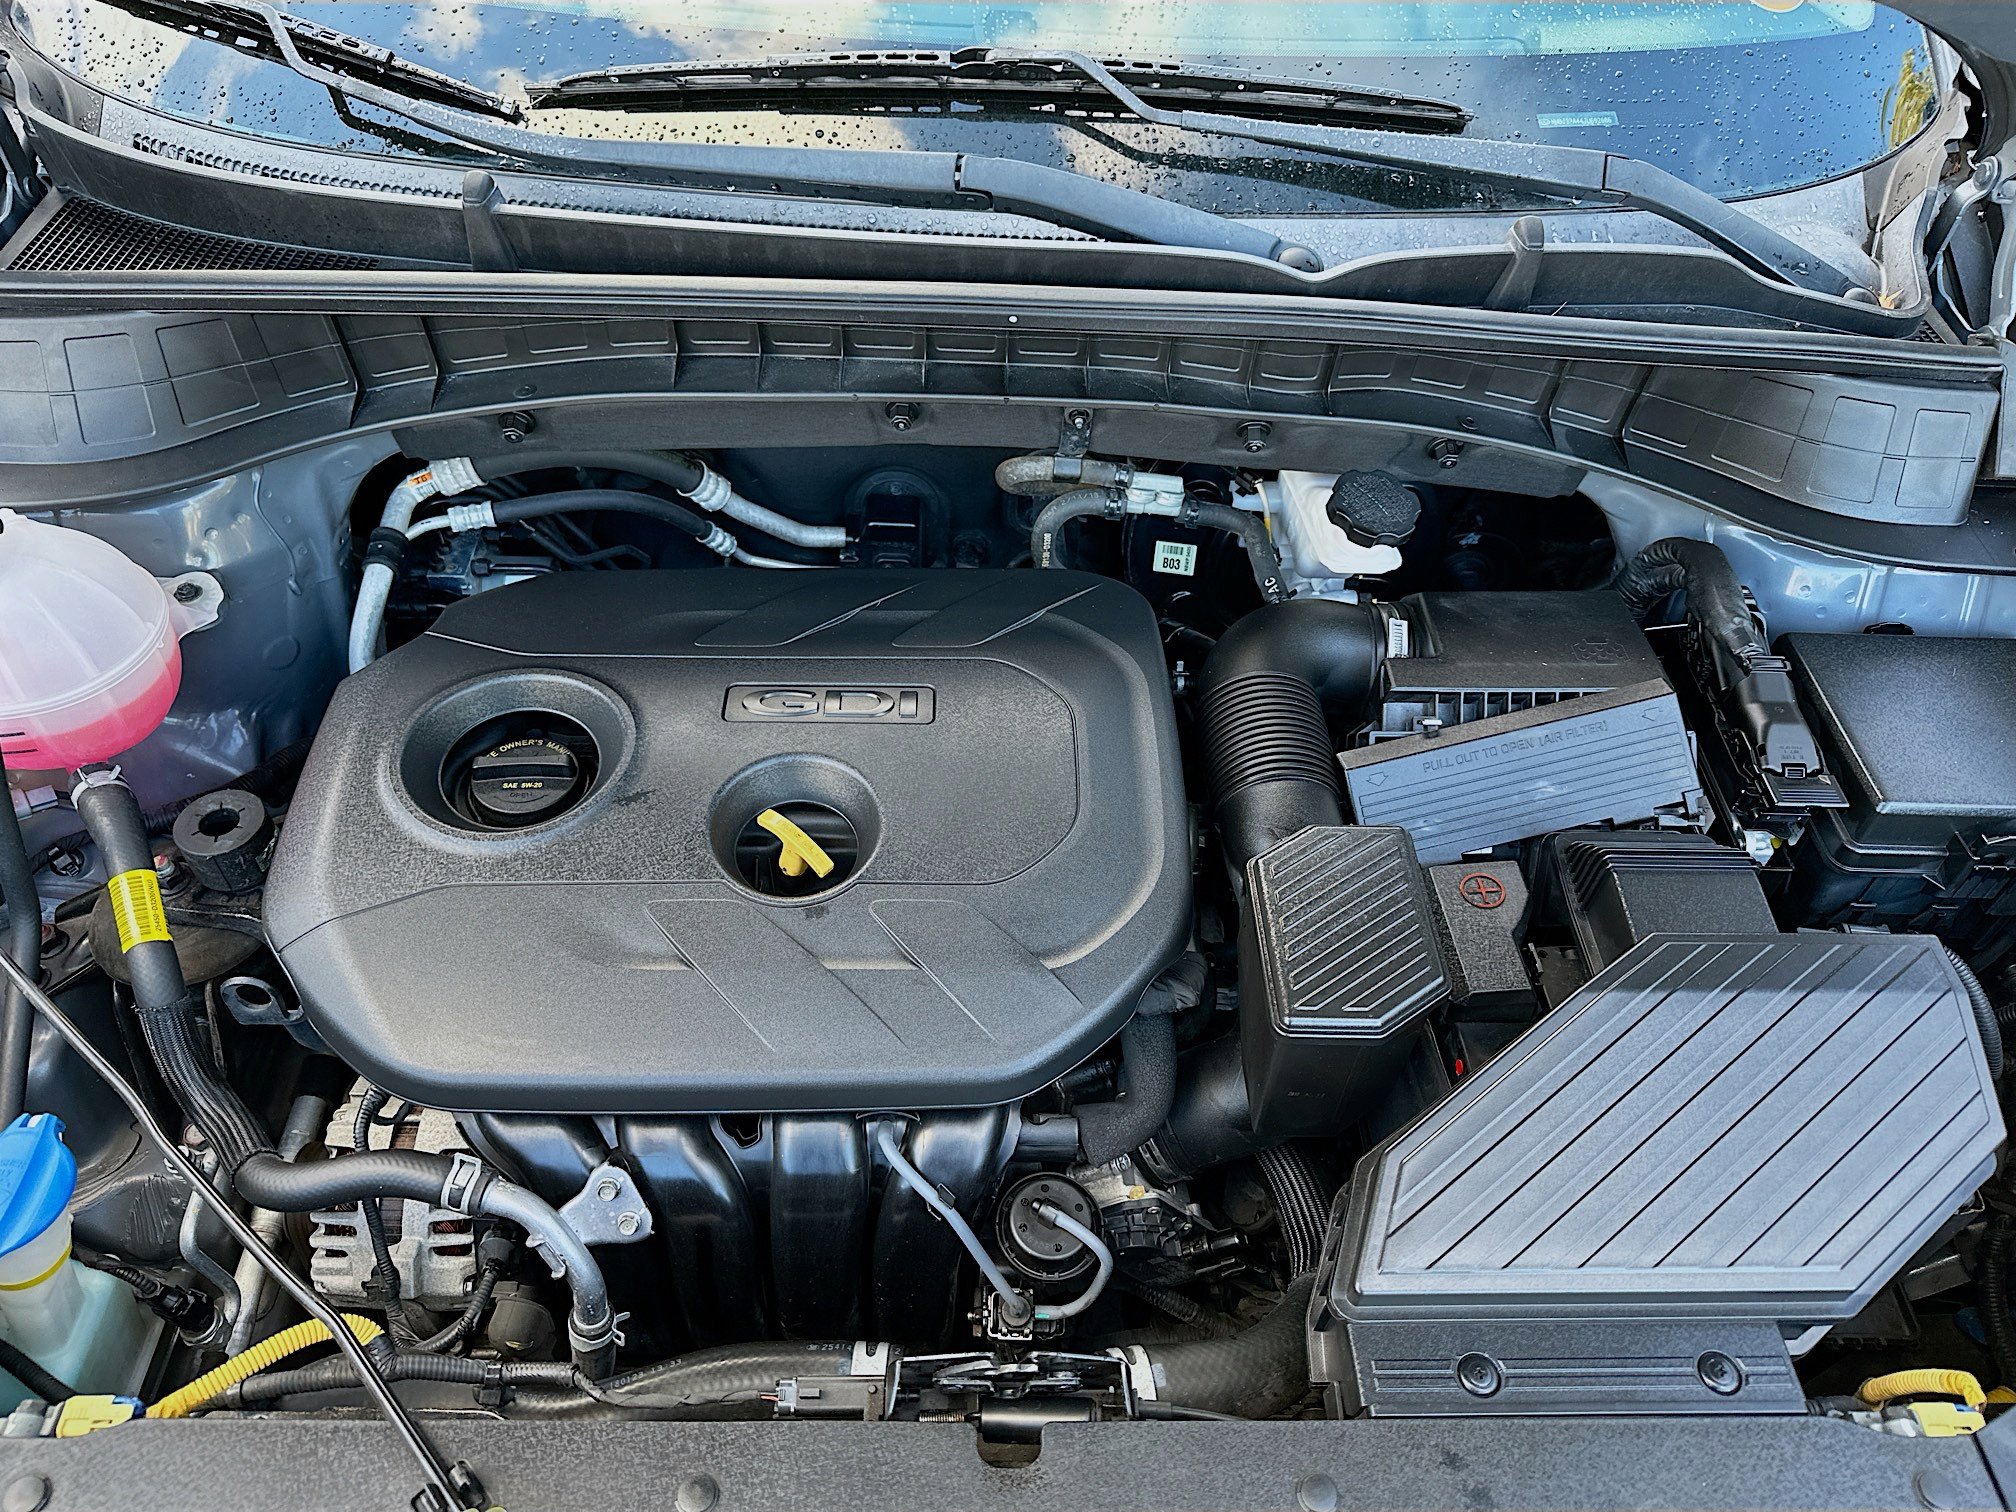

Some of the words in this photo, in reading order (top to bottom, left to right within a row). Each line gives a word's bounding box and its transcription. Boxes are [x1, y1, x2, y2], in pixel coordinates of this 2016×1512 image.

[1162, 557, 1181, 570] B03
[741, 689, 918, 718] GDI
[499, 739, 544, 752] OWNER'S
[1422, 757, 1454, 773] PULL
[1456, 750, 1480, 765] OUT
[1482, 746, 1498, 759] TO
[1500, 737, 1535, 754] OPEN
